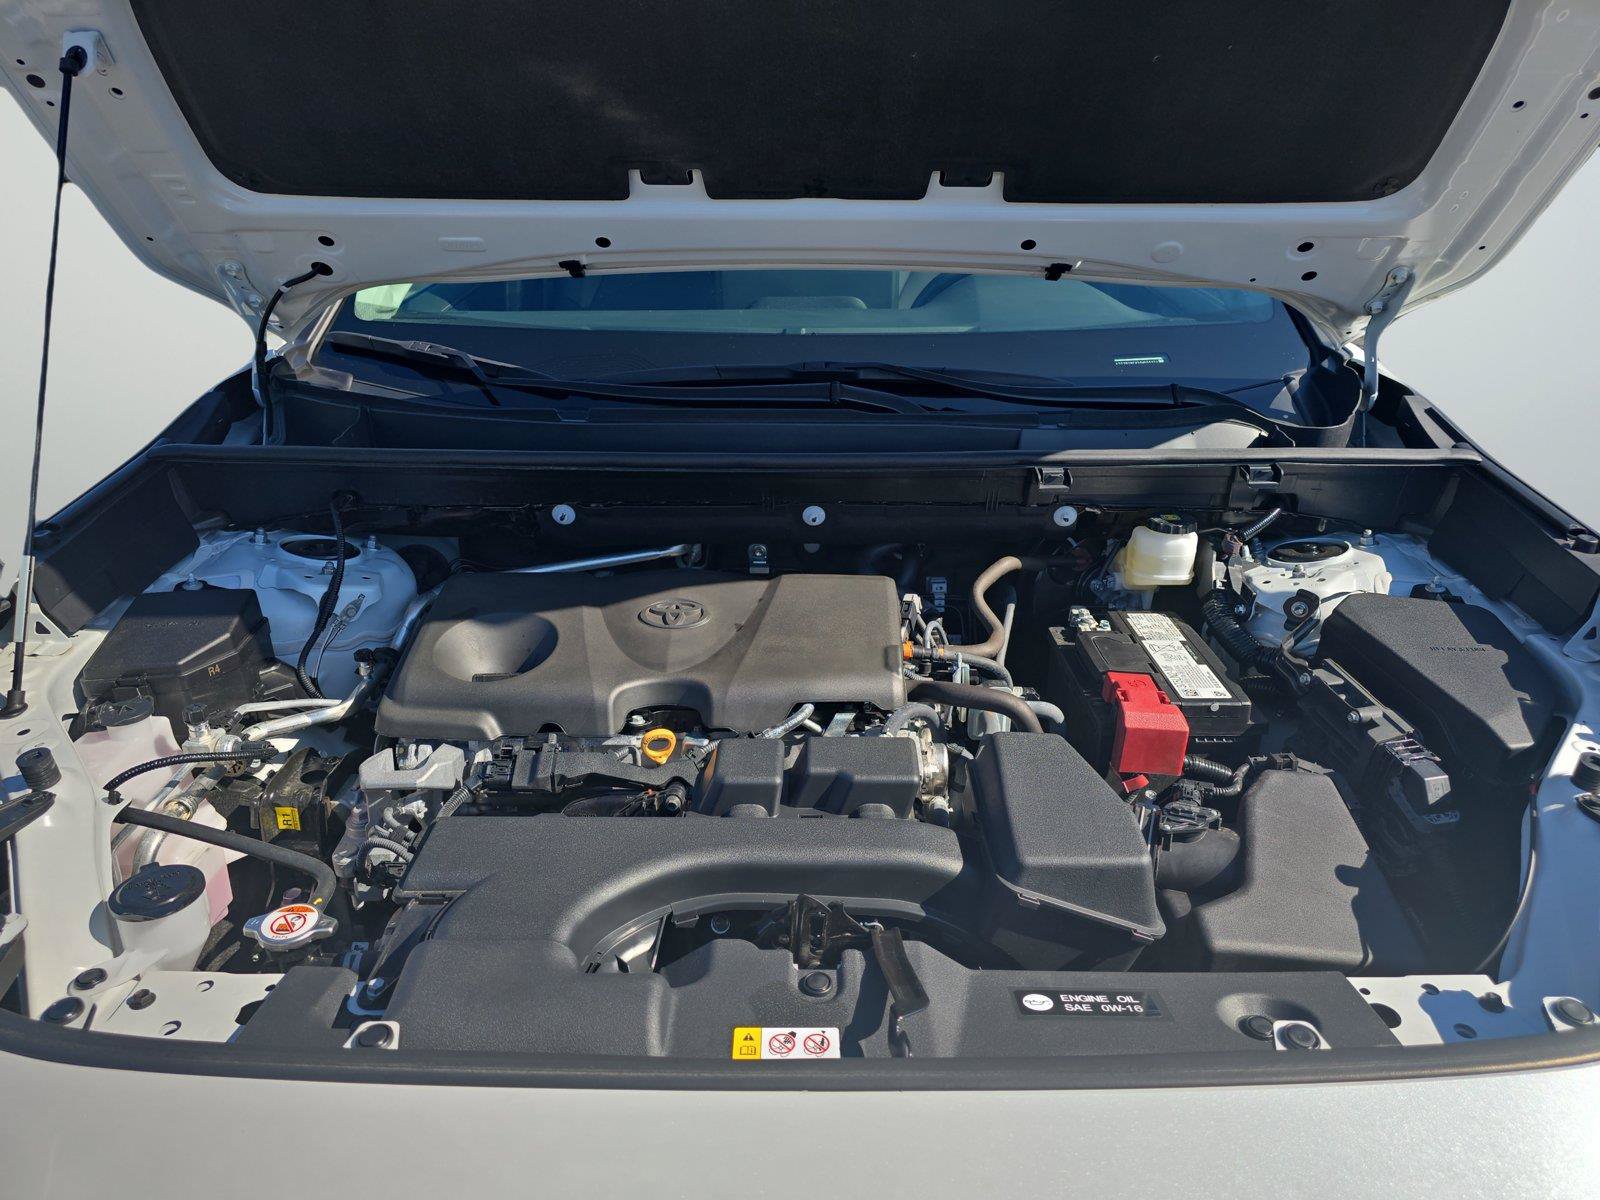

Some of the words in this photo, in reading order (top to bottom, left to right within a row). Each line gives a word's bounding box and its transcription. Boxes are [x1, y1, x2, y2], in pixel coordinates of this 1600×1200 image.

[1059, 994, 1110, 1003] ENGINE
[1116, 995, 1140, 1003] OIL
[1064, 1003, 1093, 1012] SAE
[1101, 1004, 1144, 1013] 0W-16
